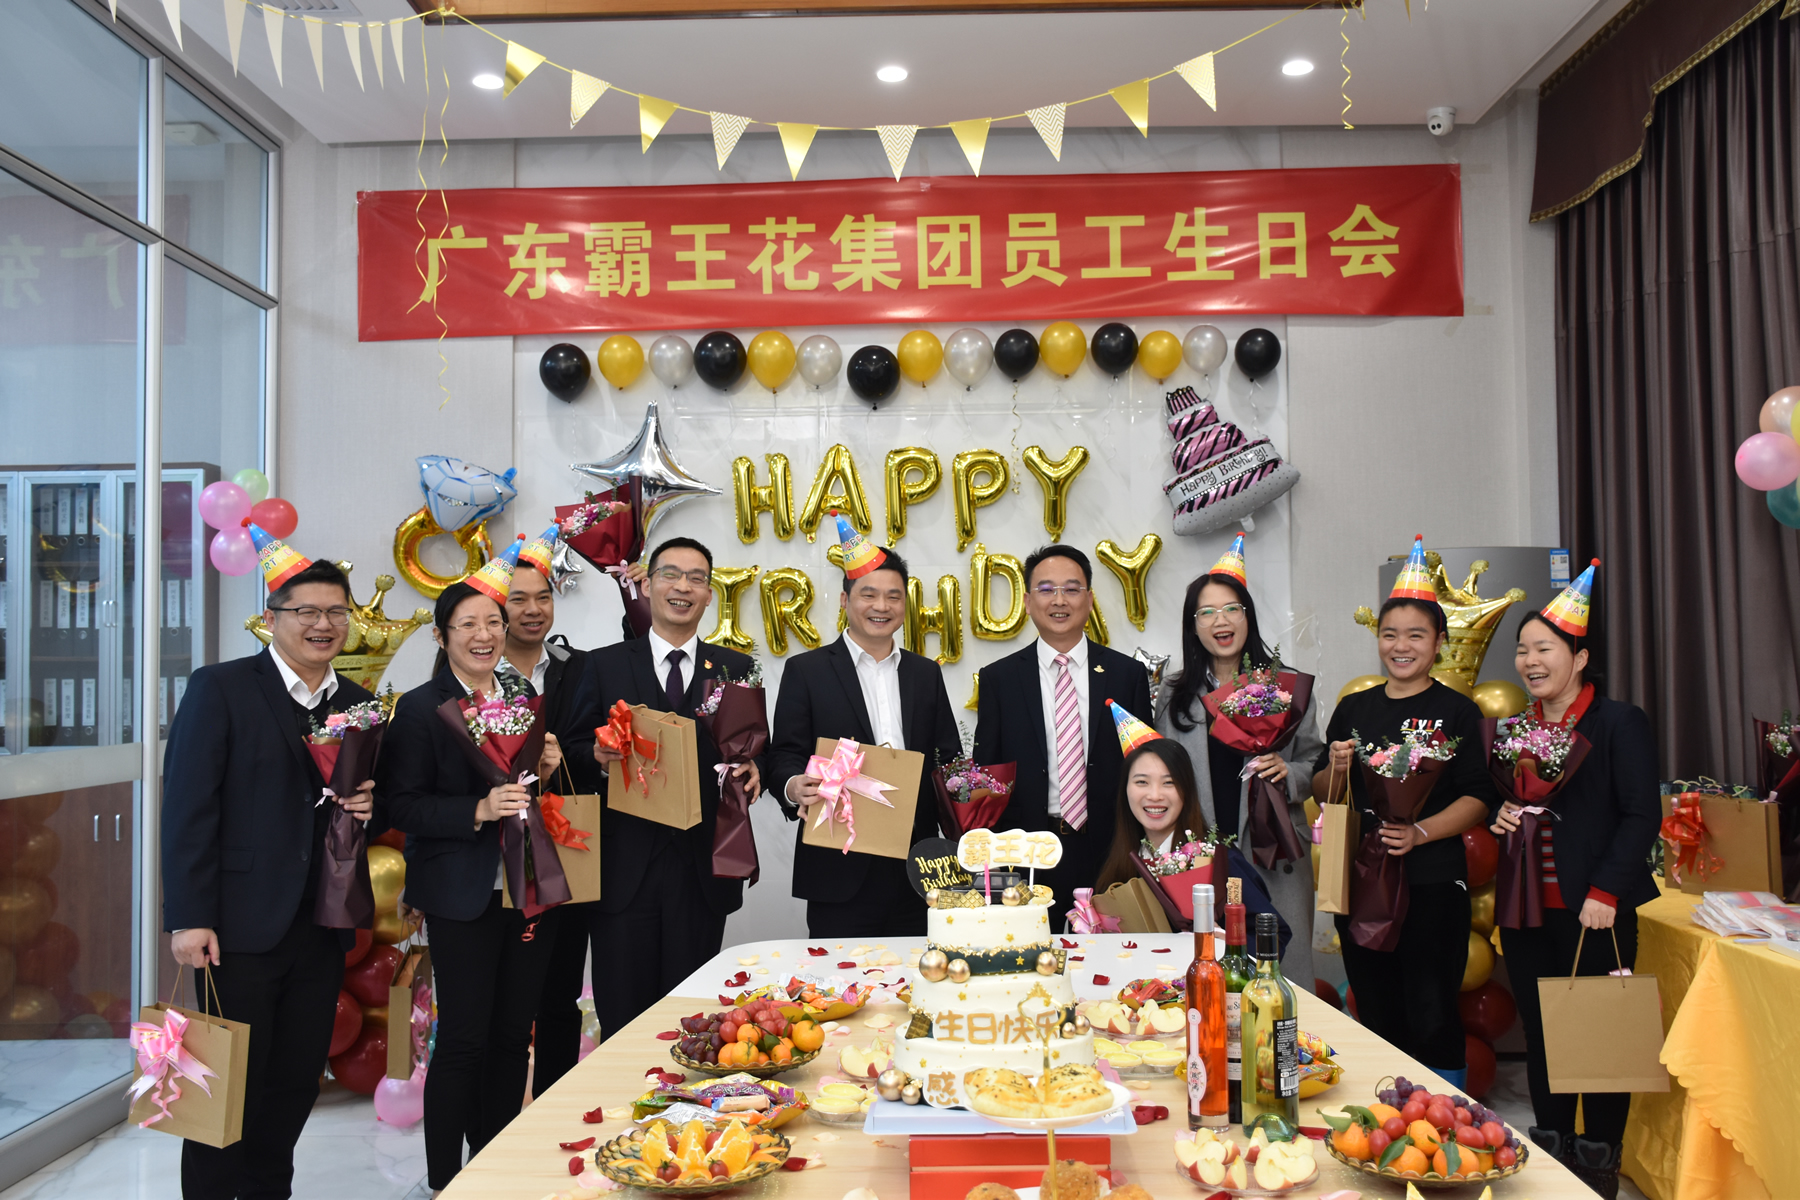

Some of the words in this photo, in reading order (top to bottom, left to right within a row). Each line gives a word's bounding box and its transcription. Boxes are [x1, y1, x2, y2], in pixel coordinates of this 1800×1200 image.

[420, 204, 1400, 302] 广东霸王花集团员工生日会
[732, 443, 1091, 552] HAPPY
[915, 854, 960, 878] Happy
[963, 831, 1058, 867] 霸王花
[920, 871, 973, 892] Birthday
[935, 1010, 1060, 1044] 生日快乐
